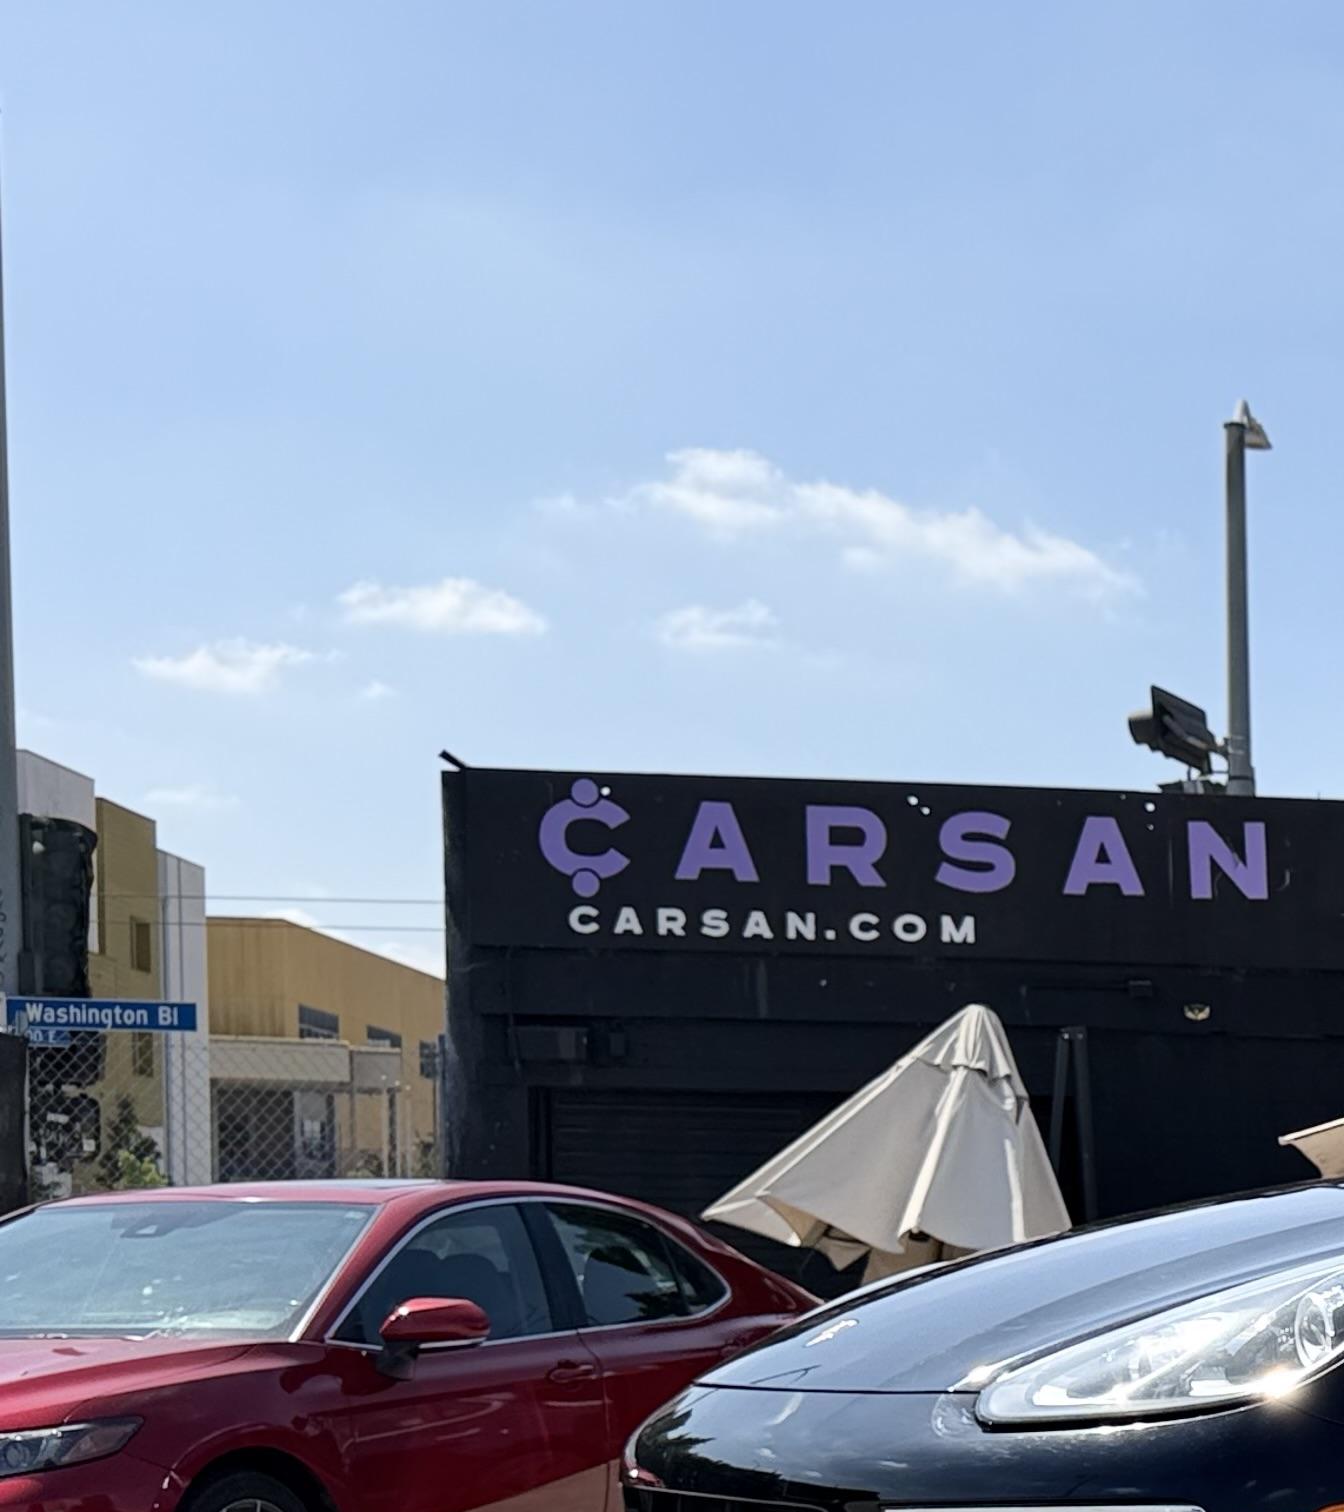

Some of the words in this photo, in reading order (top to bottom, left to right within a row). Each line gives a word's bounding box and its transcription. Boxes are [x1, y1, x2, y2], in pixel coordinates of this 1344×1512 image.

[539, 778, 1269, 900] CARSAN
[568, 906, 976, 944] CARSAN.COM
[25, 1002, 148, 1028] Washington
[158, 1006, 178, 1026] Bl
